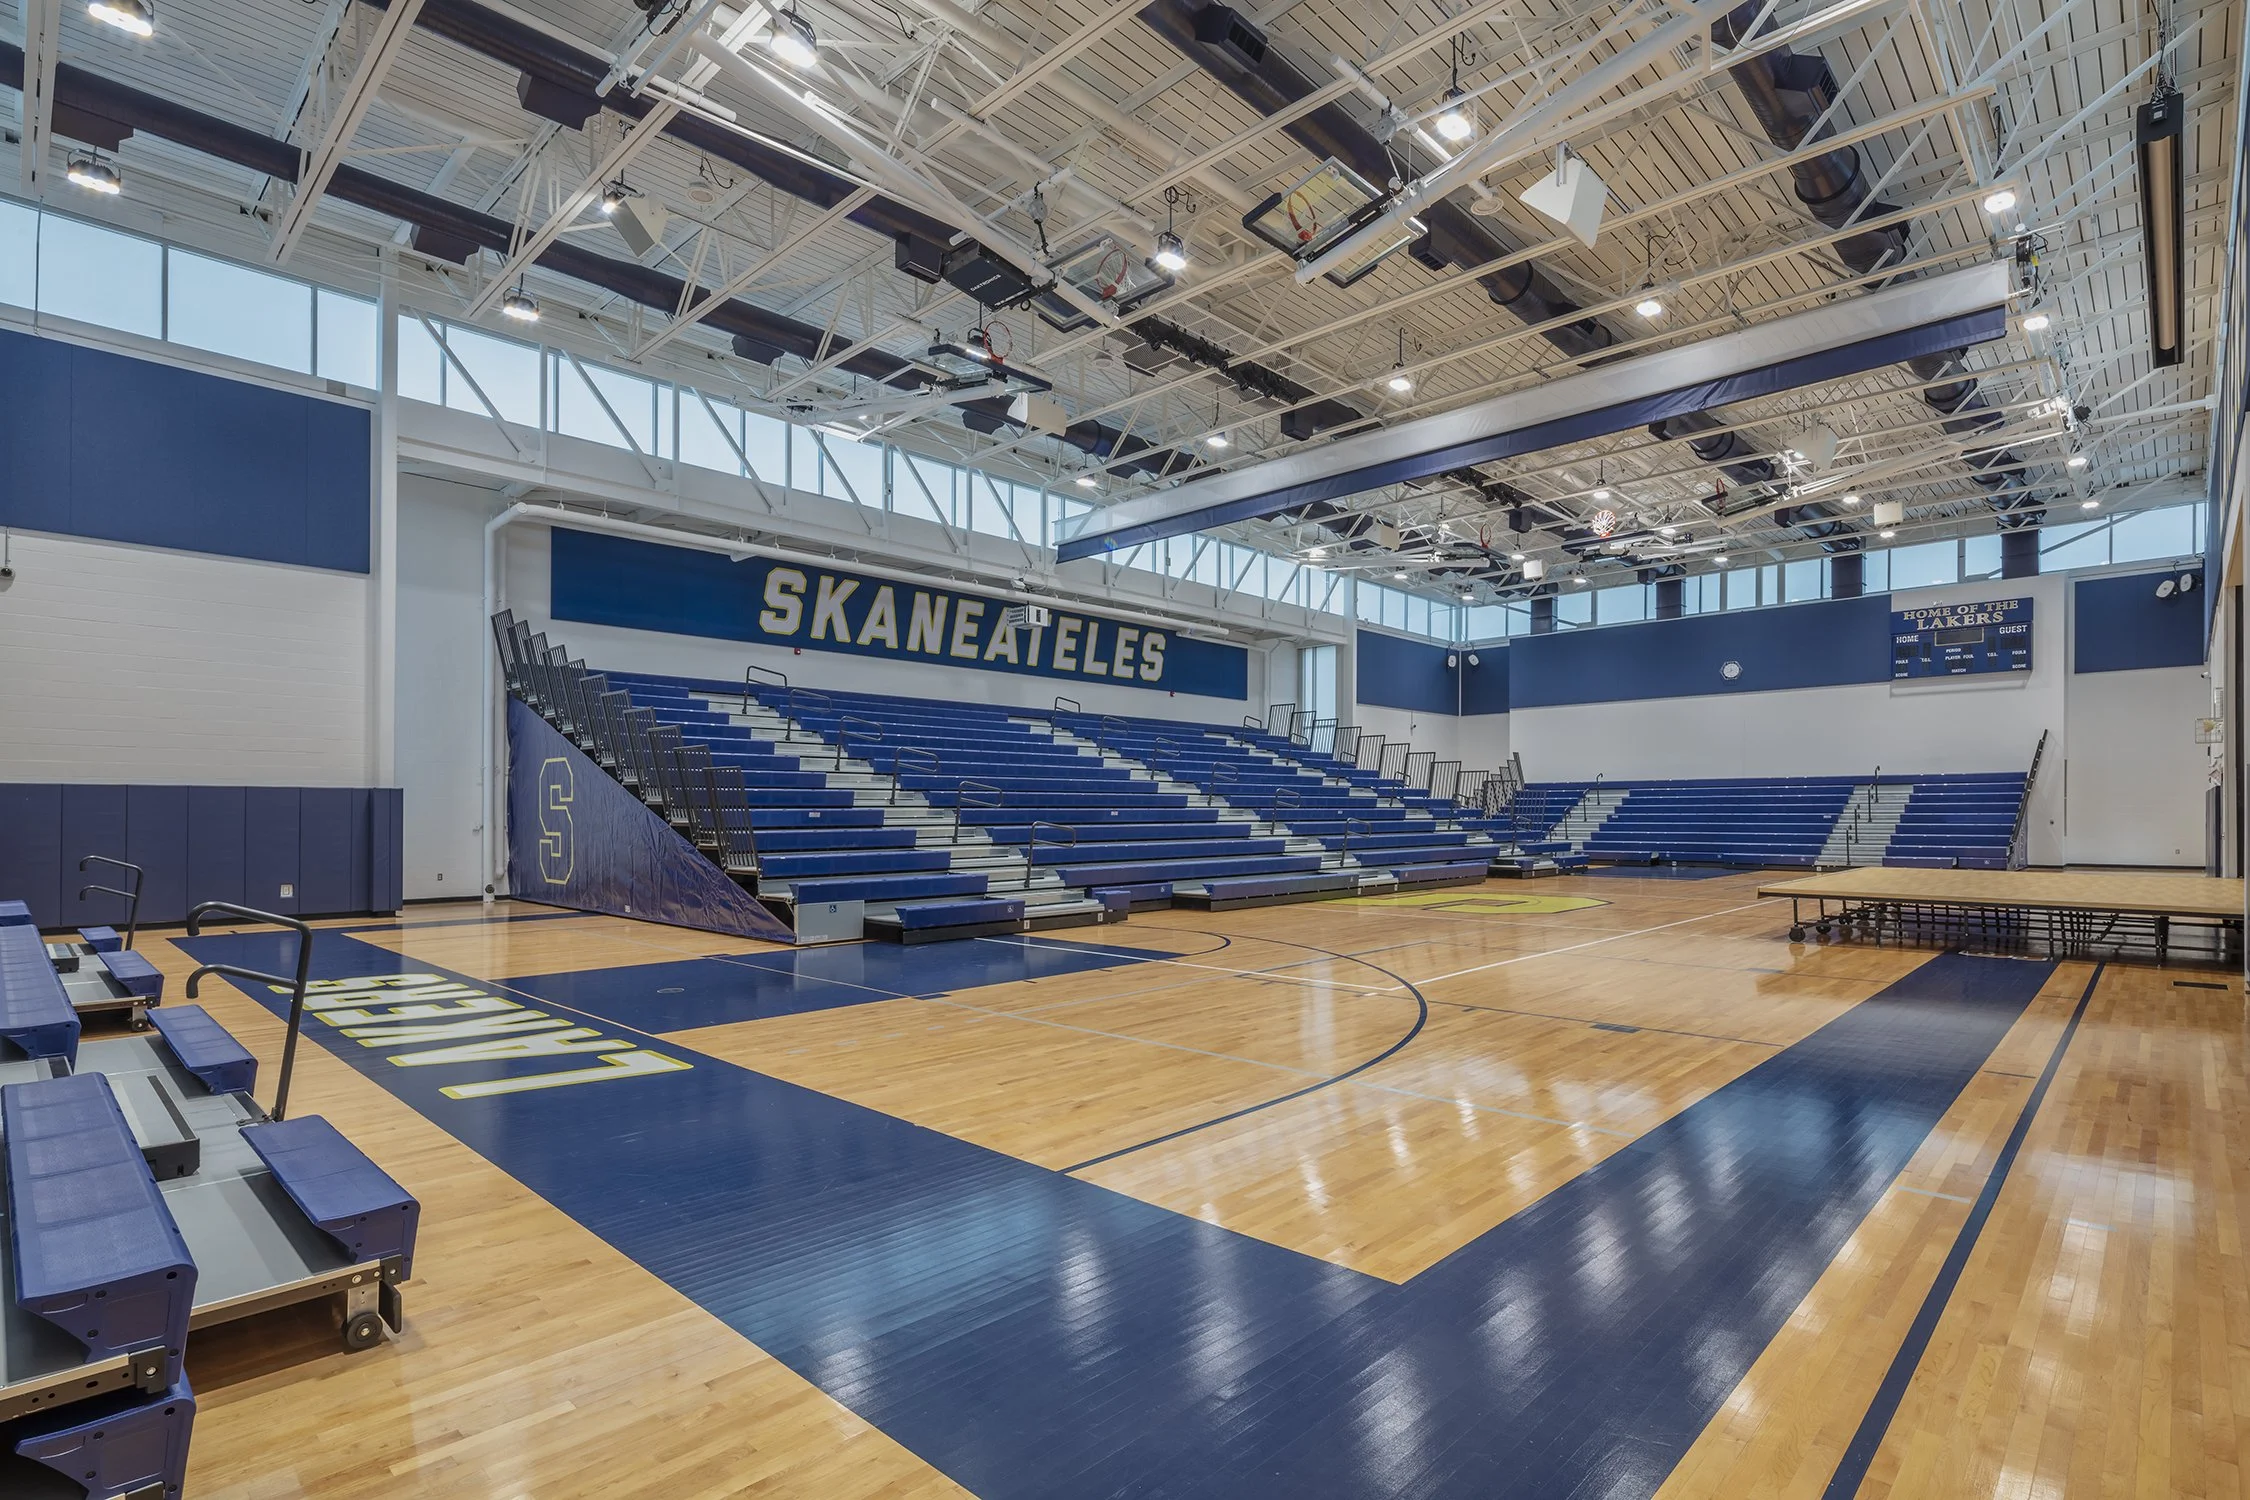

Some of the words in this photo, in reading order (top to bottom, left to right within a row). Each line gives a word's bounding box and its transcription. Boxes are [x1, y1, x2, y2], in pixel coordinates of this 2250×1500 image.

[1903, 608, 1951, 620] HOME
[1957, 604, 1978, 615] OF
[1984, 600, 2019, 611] THE
[1917, 611, 2004, 630] LAKERS
[1999, 625, 2027, 634] GUEST
[1896, 635, 1919, 643] HOME
[539, 757, 573, 885] S
[267, 973, 694, 1100] LAKERS
